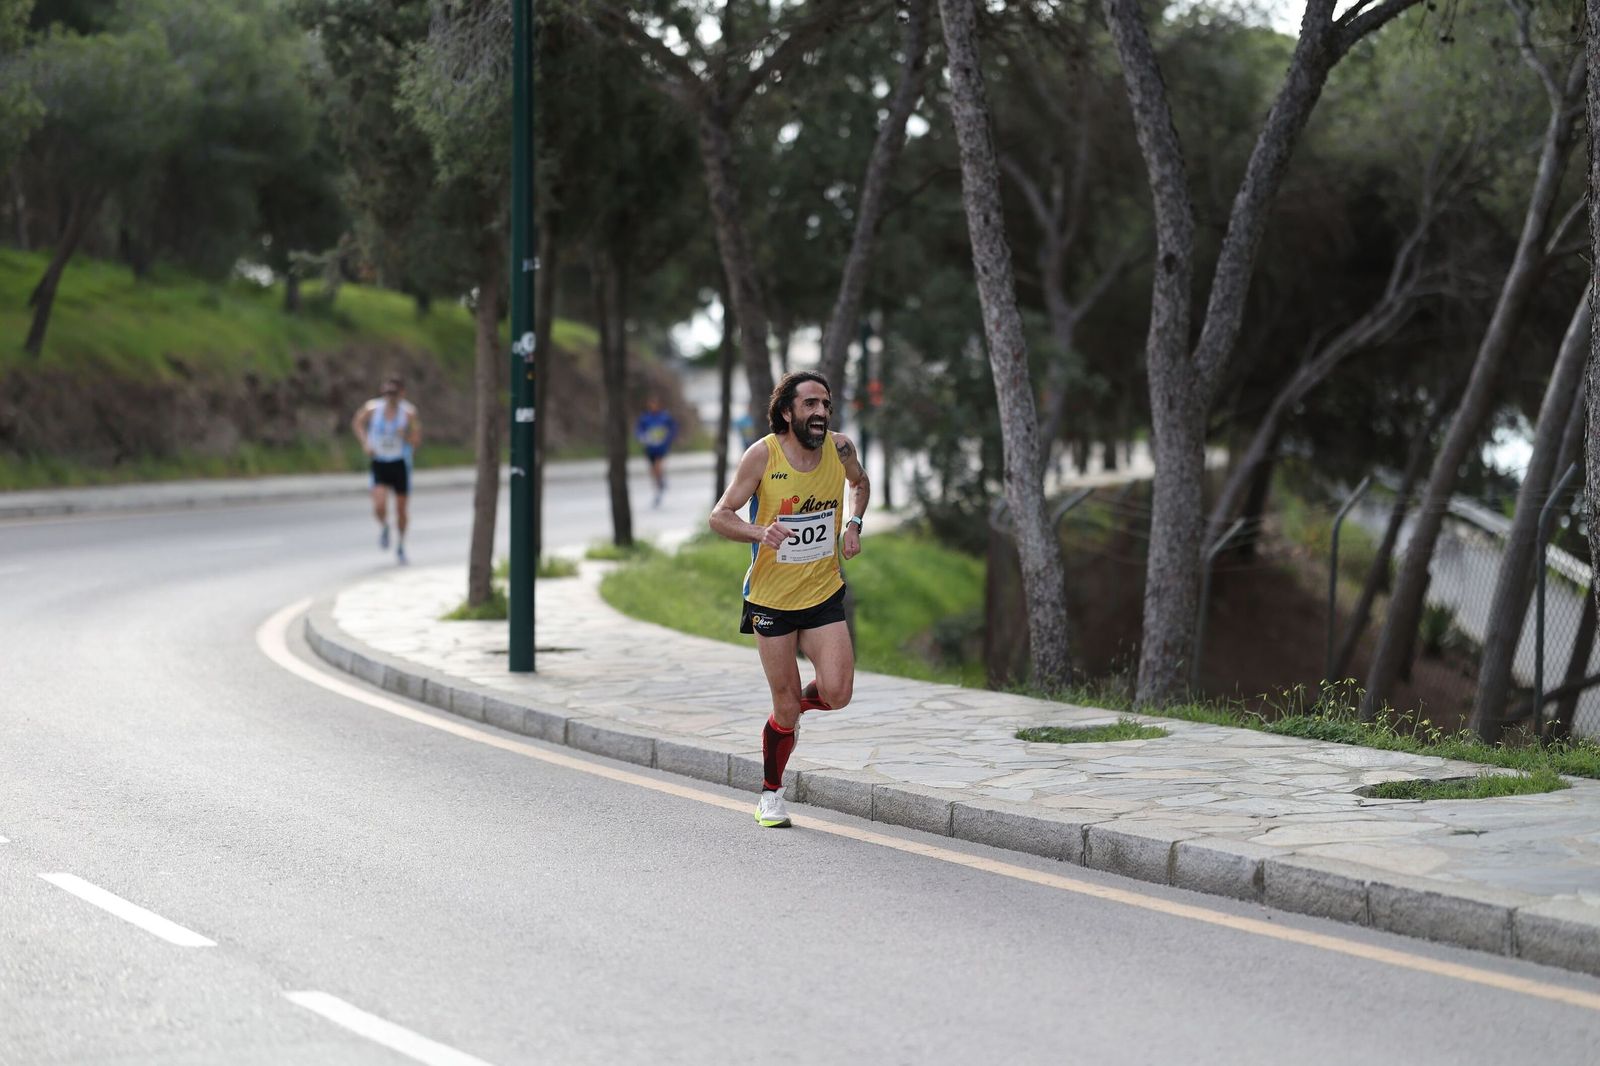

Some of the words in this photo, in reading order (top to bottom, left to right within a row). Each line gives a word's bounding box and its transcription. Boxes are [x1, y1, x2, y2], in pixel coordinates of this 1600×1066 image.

[771, 472, 788, 480] vive
[800, 495, 838, 513] Álora
[788, 524, 827, 546] 502
